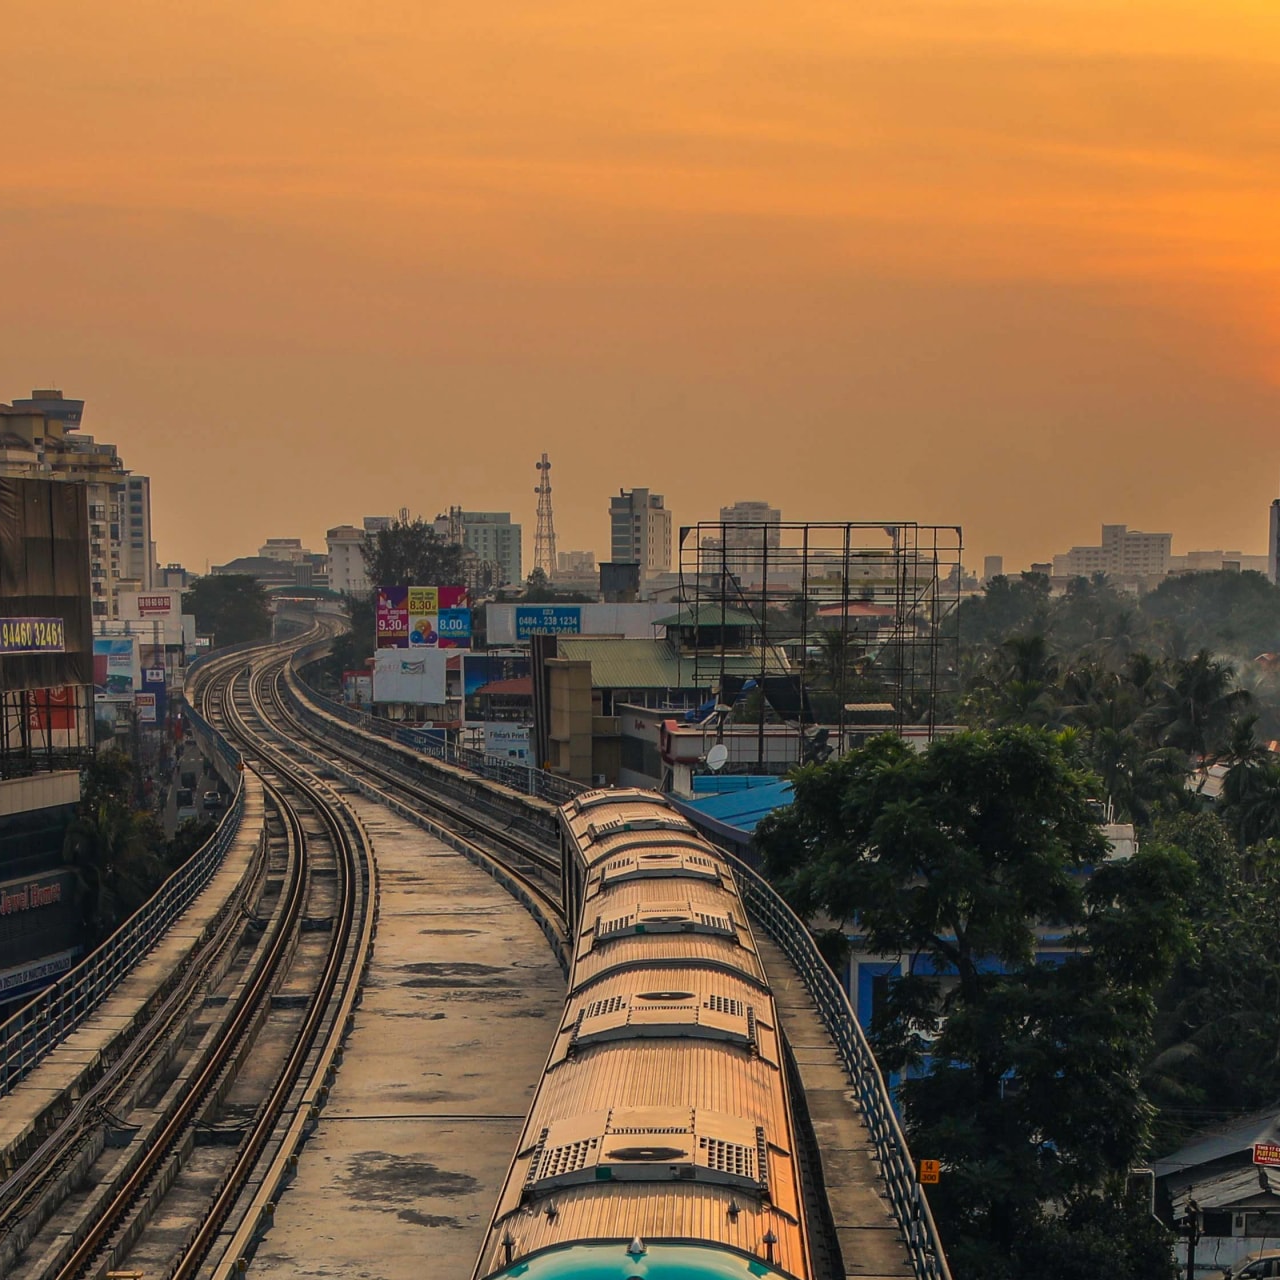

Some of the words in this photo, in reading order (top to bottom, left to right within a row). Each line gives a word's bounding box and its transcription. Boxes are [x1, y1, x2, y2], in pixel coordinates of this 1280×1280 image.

[410, 600, 432, 610] 8.30
[378, 619, 402, 631] 9.30
[439, 619, 463, 630] 8.00
[543, 616, 557, 625] 238
[559, 616, 577, 625] 1234
[2, 623, 32, 648] 94460
[34, 622, 63, 647] 32461
[0, 884, 30, 916] Jewel
